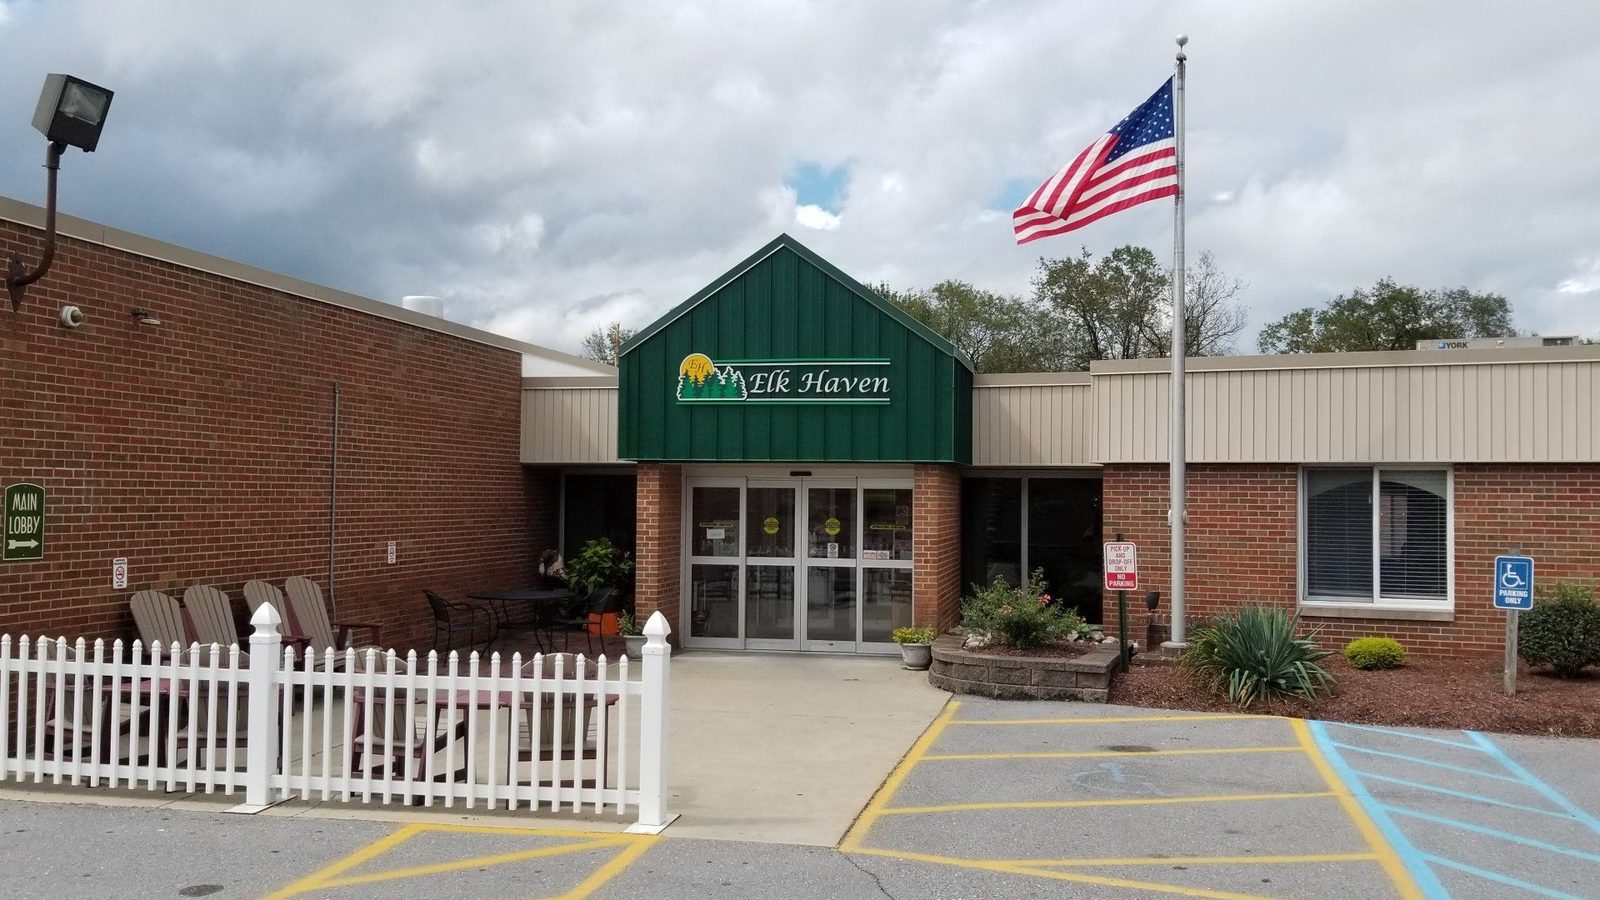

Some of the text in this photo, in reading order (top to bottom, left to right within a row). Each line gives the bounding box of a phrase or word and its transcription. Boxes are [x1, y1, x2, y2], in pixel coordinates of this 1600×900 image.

[1446, 341, 1468, 349] YORK
[688, 359, 707, 373] EH
[749, 369, 890, 394] Elk Haven
[12, 493, 38, 511] MAIN
[8, 516, 40, 534] LOBBY
[1108, 558, 1133, 566] DROP-OFF
[1108, 580, 1135, 588] PARKING
[1499, 589, 1528, 598] PARKING
[1504, 597, 1523, 605] ONLY
